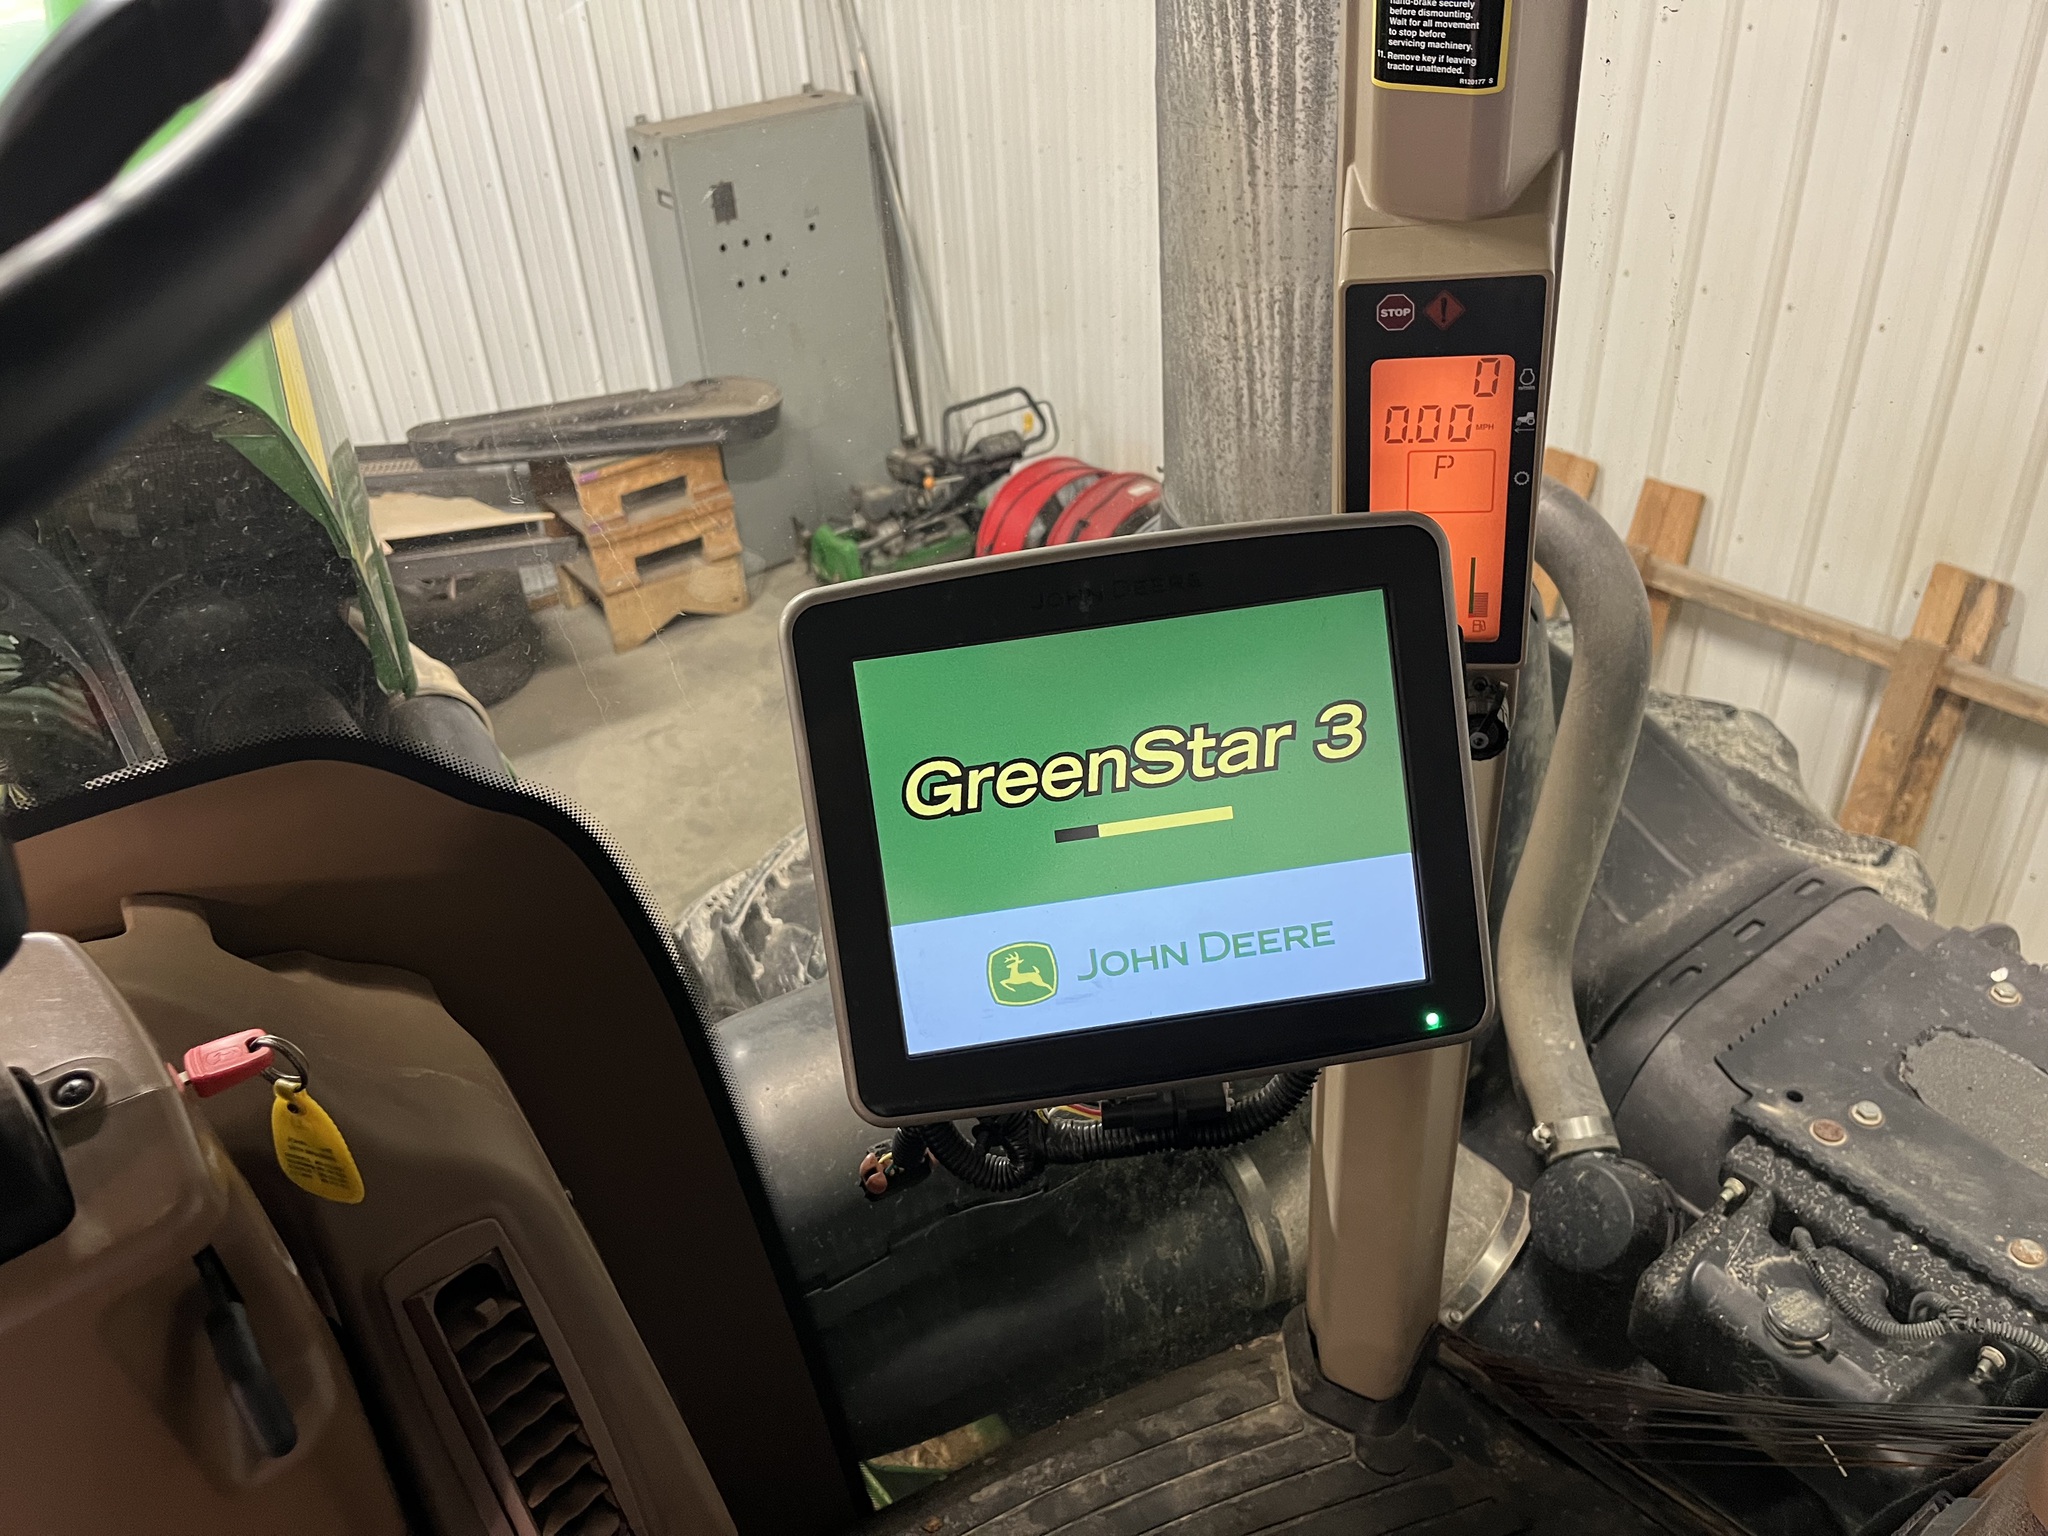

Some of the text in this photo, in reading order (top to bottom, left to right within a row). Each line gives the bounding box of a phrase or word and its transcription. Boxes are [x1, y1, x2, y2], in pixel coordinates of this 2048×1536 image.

[1439, 0, 1475, 10] securely
[1389, 6, 1473, 20] before dismounting.
[1389, 17, 1480, 30] Wait for all movement
[1389, 28, 1446, 39] to stop before
[1388, 38, 1473, 51] servicing machinery.
[1377, 49, 1477, 66] 11. Remove key if leaving
[1387, 62, 1464, 74] tractor unattended.
[1381, 307, 1412, 318] STOP
[1473, 357, 1501, 398] 0
[1384, 404, 1495, 444] 0.00 MPH
[1434, 455, 1455, 480] P
[901, 700, 1367, 820] GreenStar 3
[1078, 921, 1335, 982] JOHN DEERE
